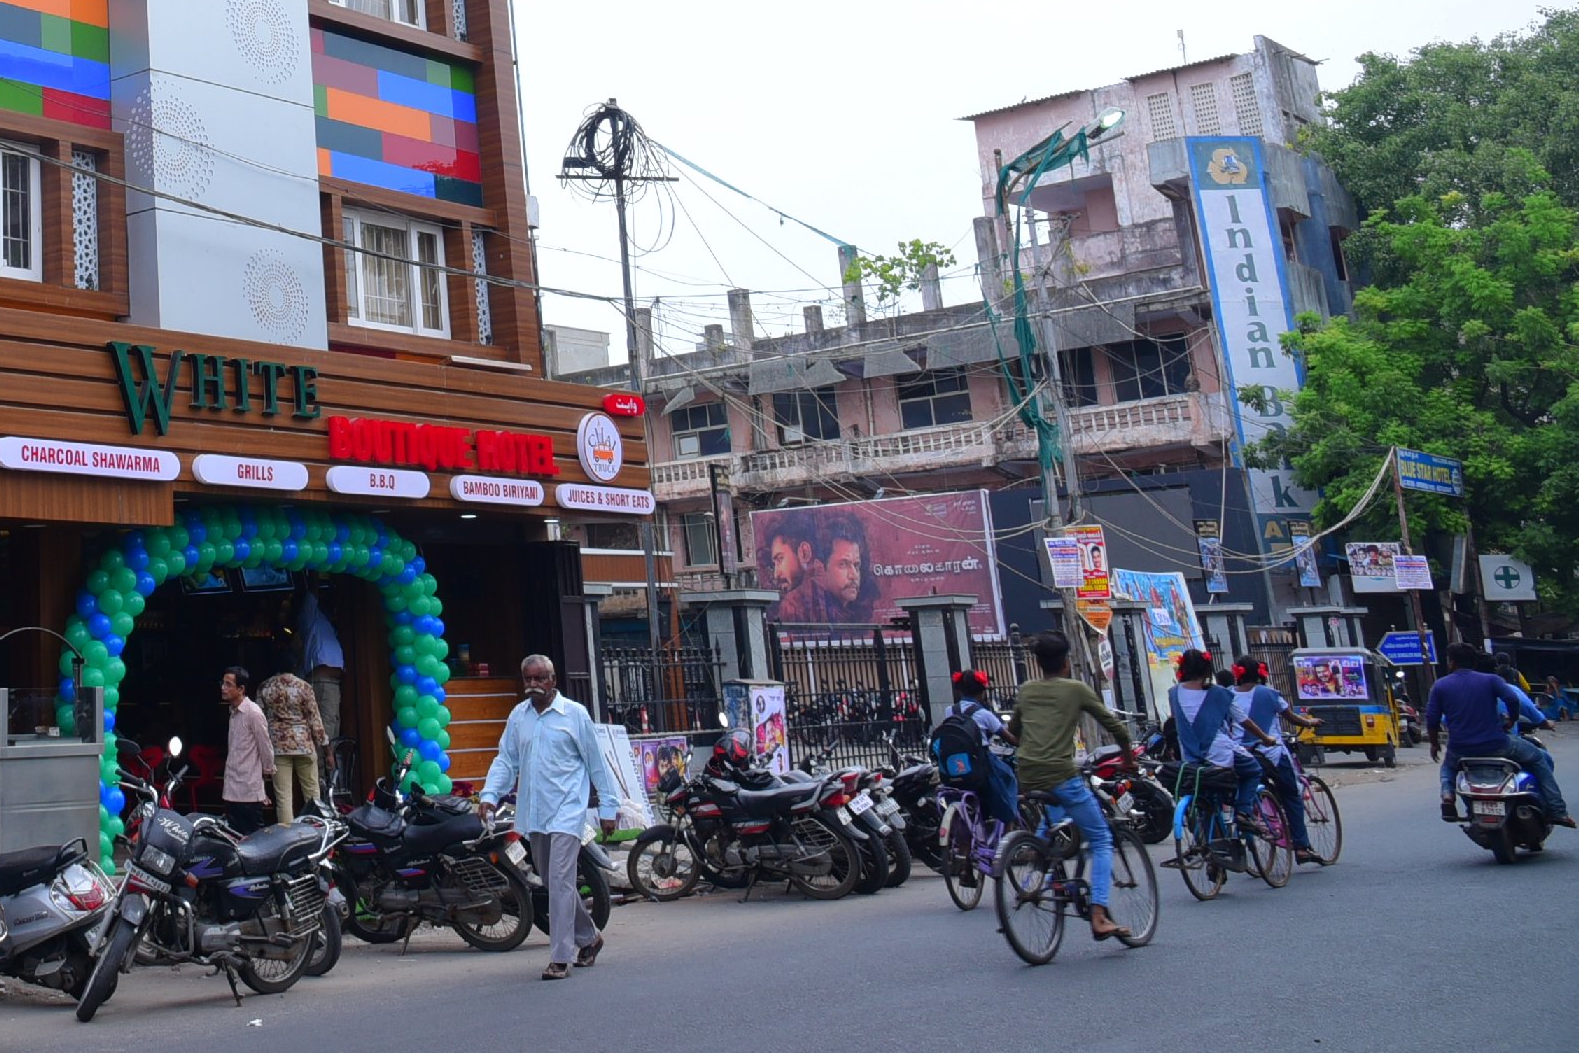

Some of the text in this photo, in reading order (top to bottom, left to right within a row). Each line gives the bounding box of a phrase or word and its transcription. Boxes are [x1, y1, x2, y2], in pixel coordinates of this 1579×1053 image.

[1224, 195, 1276, 369] Indian
[105, 340, 321, 437] WHITE
[615, 397, 639, 414] وايت
[327, 415, 561, 476] BOUTIQUE HOTEL
[21, 444, 161, 474] CHARCOAL SHAWARMA
[593, 462, 617, 474] TRUCK
[236, 462, 274, 482] GRILLS
[369, 472, 396, 490] B.B.Q
[463, 480, 539, 501] BAMBOO BIRIYANI
[567, 488, 650, 509] JUICES & SHORT EATS
